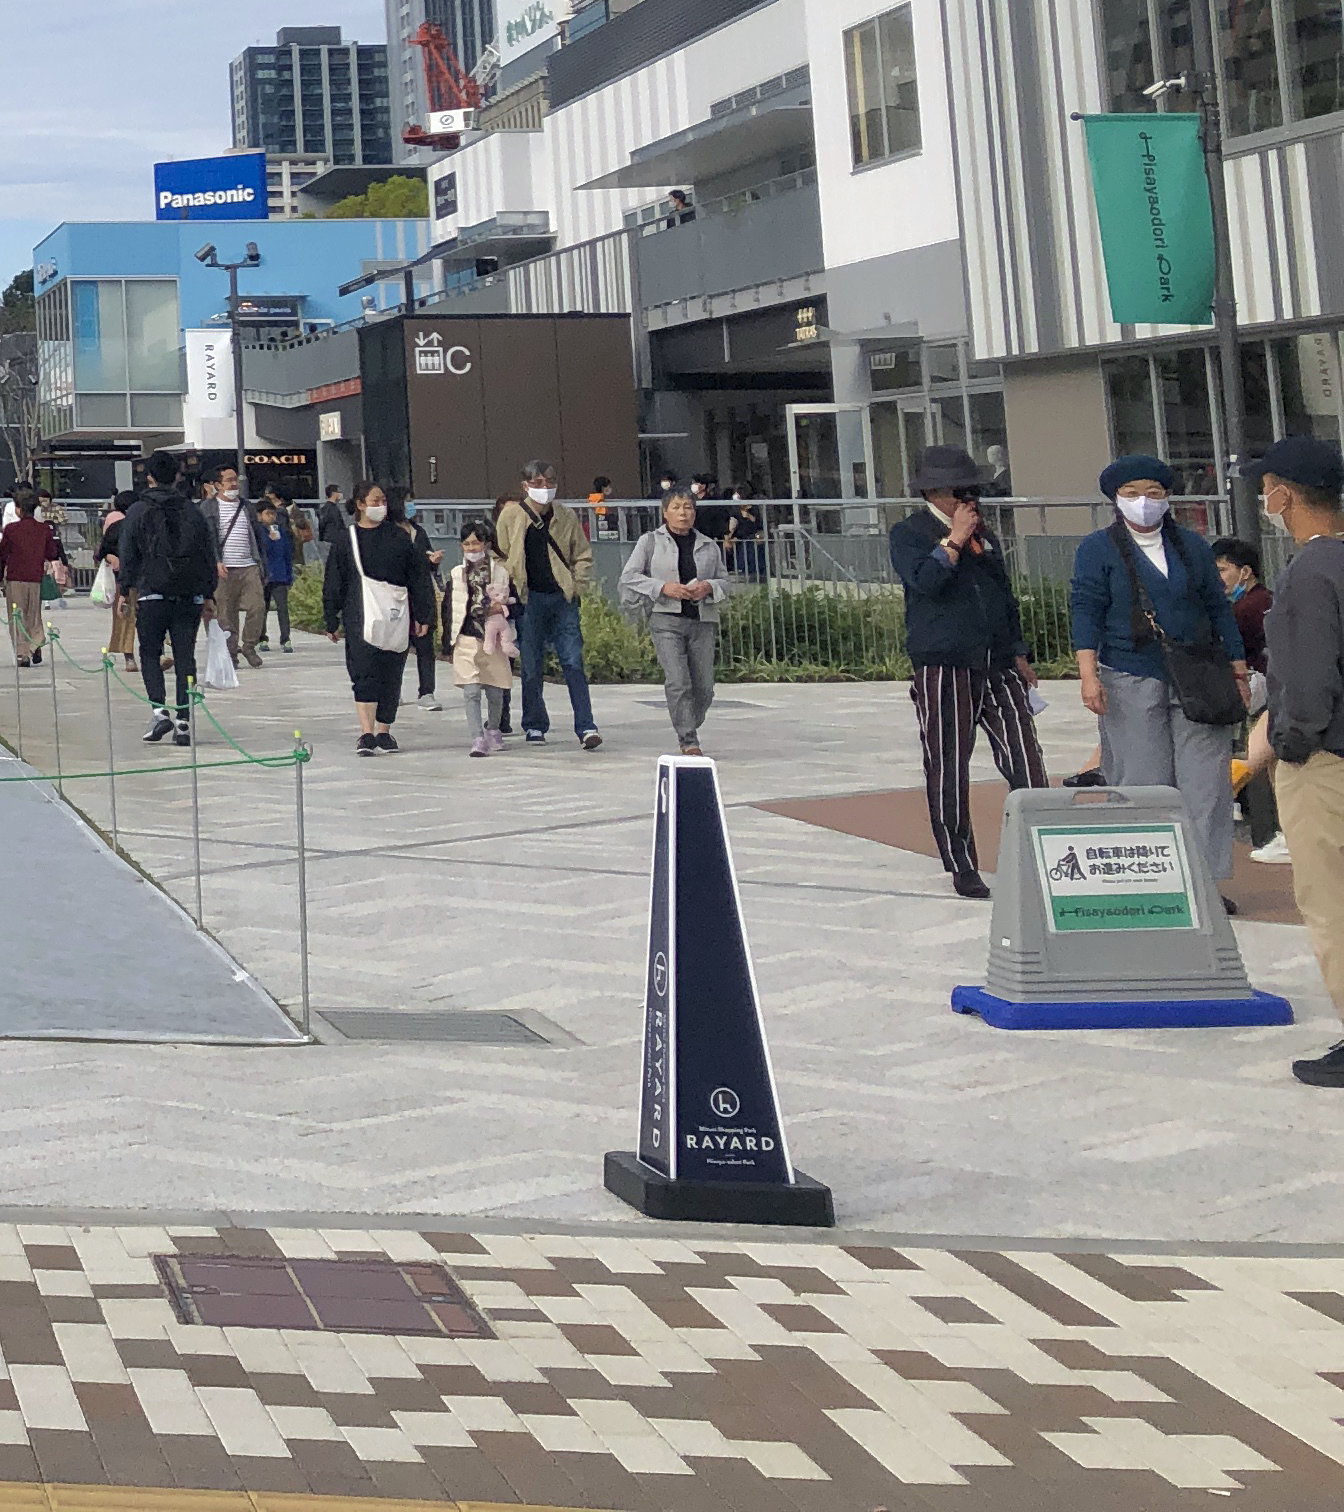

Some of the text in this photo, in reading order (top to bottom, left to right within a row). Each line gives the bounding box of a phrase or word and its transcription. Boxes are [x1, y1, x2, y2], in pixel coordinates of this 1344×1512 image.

[159, 184, 255, 209] Panasonic
[446, 346, 471, 374] C
[205, 344, 217, 401] RAYARD
[244, 455, 306, 464] COACH
[1086, 845, 1171, 860] 自転車は降りて
[1089, 861, 1175, 876] お進みください
[652, 1010, 662, 1148] RAYARD
[686, 1134, 774, 1151] RAYARD
